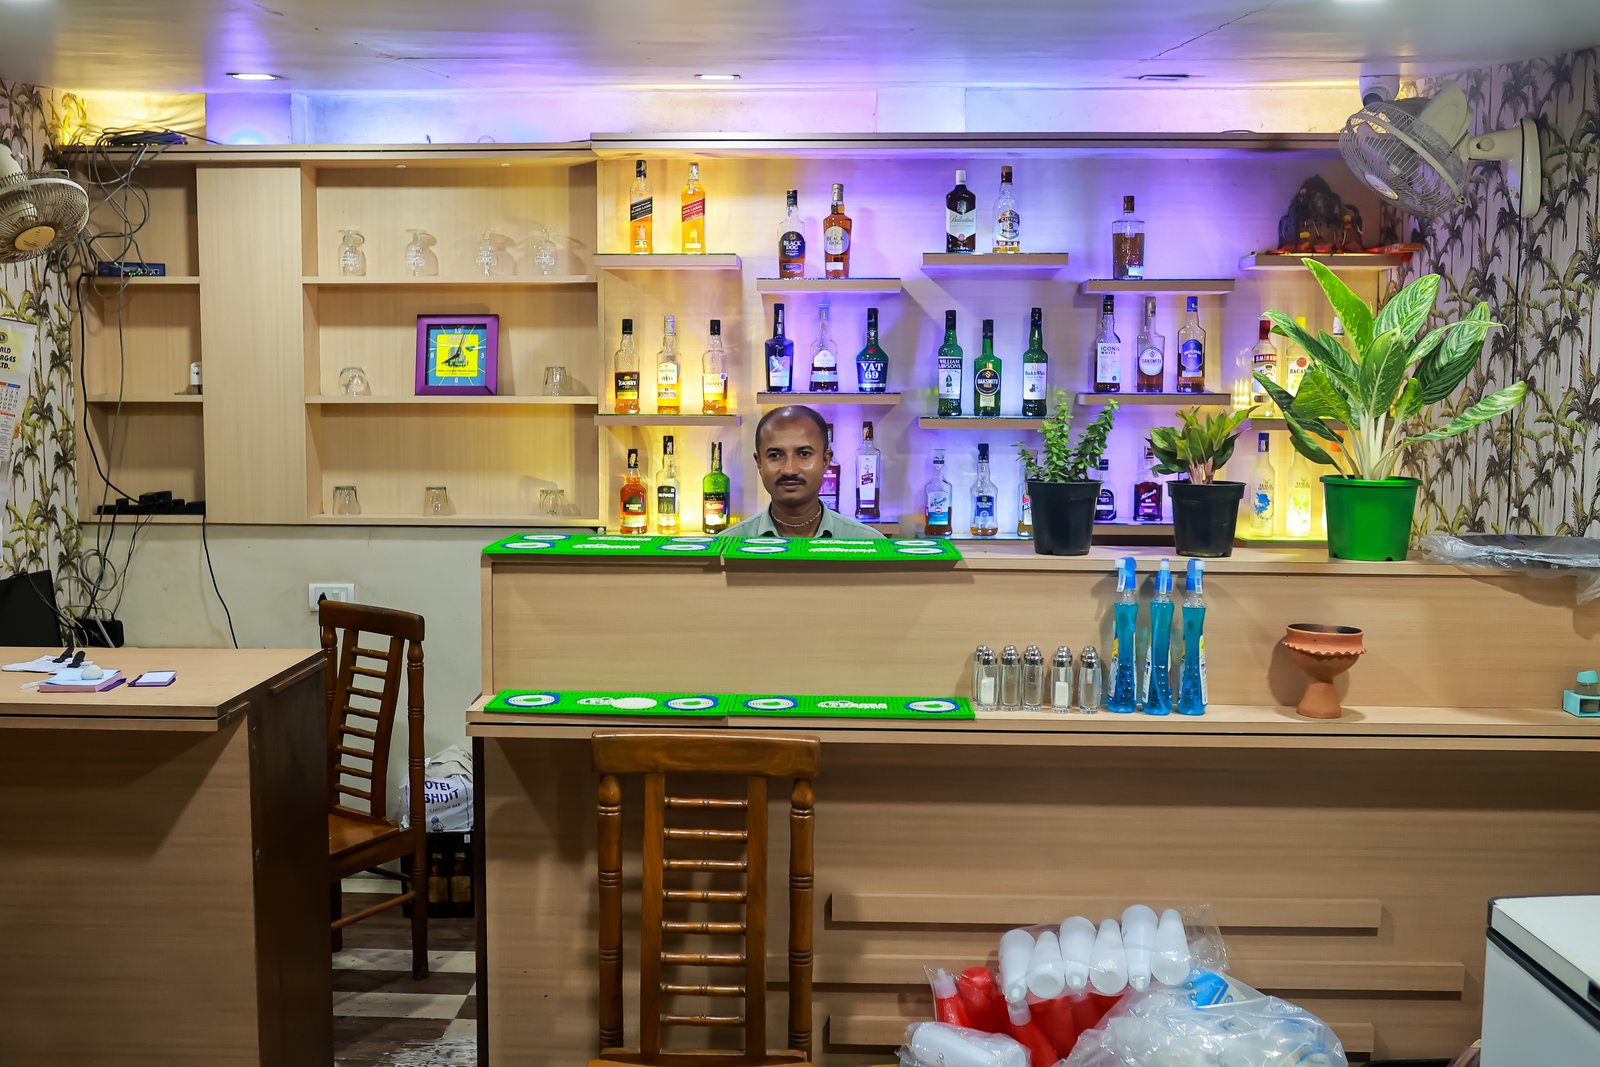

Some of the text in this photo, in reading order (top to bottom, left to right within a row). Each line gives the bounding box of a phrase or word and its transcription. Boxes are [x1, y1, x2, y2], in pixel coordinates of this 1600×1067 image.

[860, 362, 884, 372] VAT
[864, 371, 879, 380] 69
[424, 780, 453, 791] OTEL
